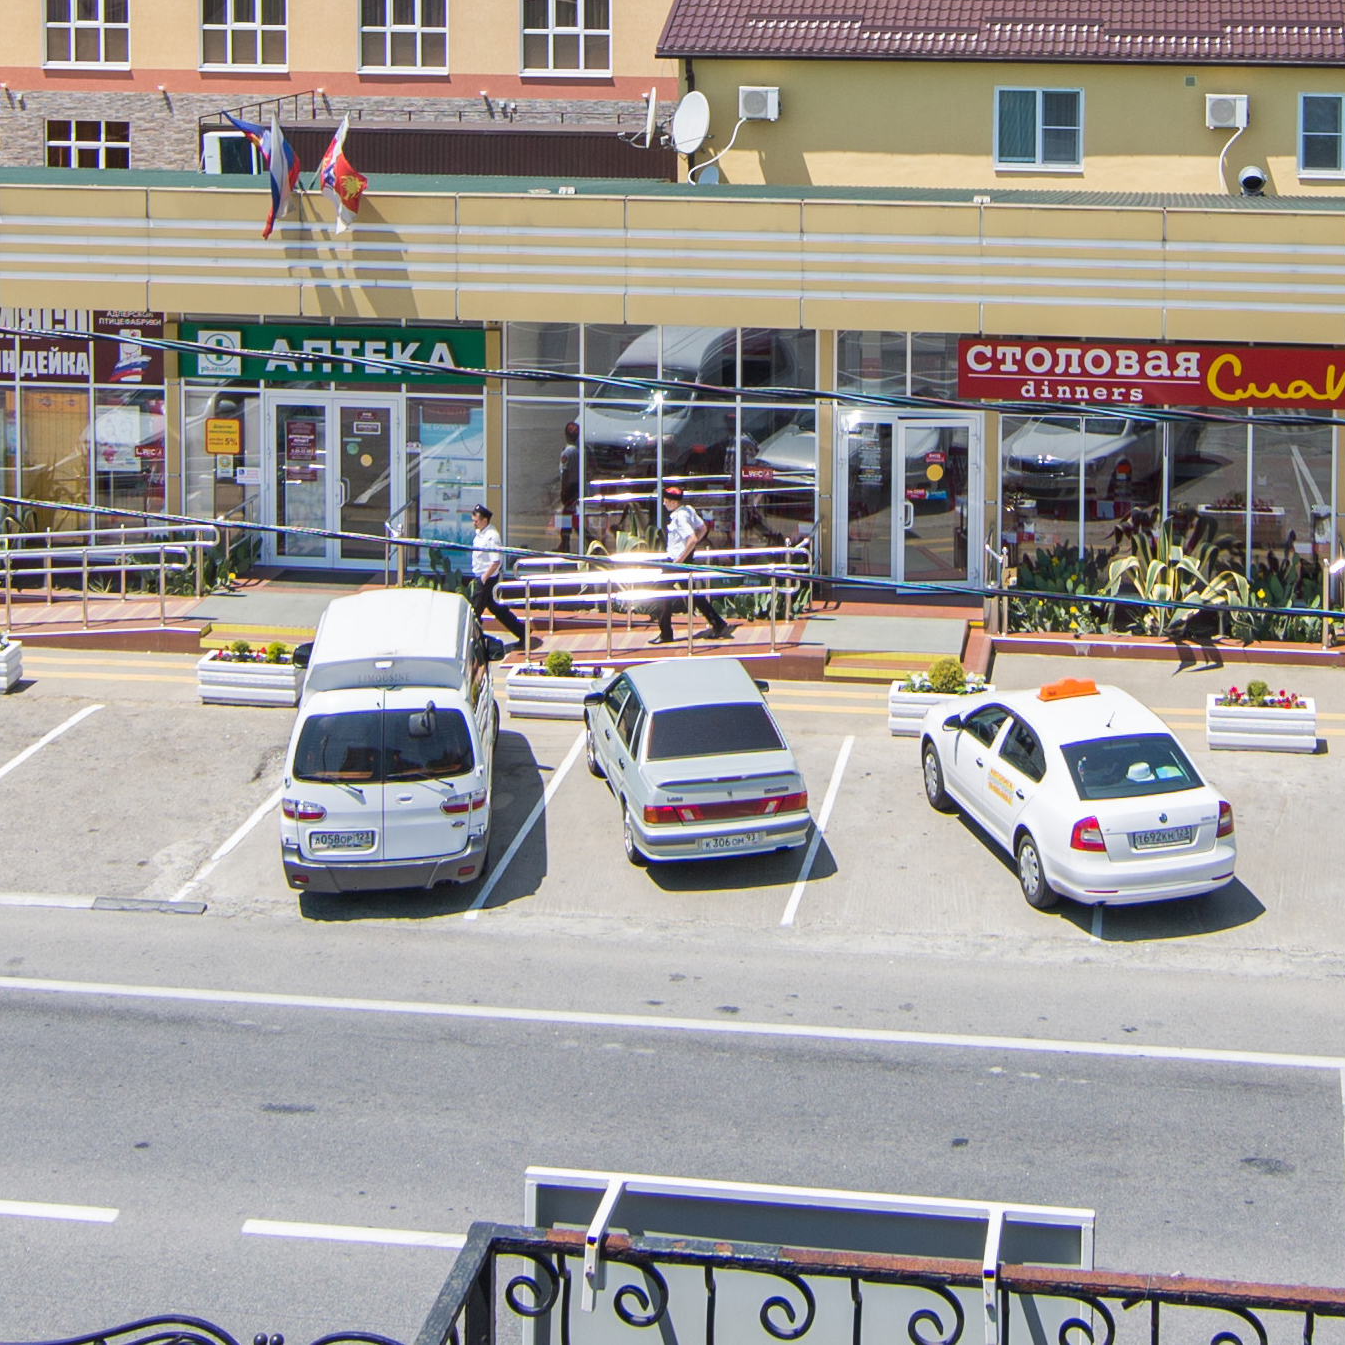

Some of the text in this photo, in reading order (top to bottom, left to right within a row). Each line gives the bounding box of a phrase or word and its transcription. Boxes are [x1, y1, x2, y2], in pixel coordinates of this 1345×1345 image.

[265, 338, 456, 376] АПТЕКА
[1021, 381, 1144, 401] dinners
[358, 673, 411, 684] LIMOUSINE
